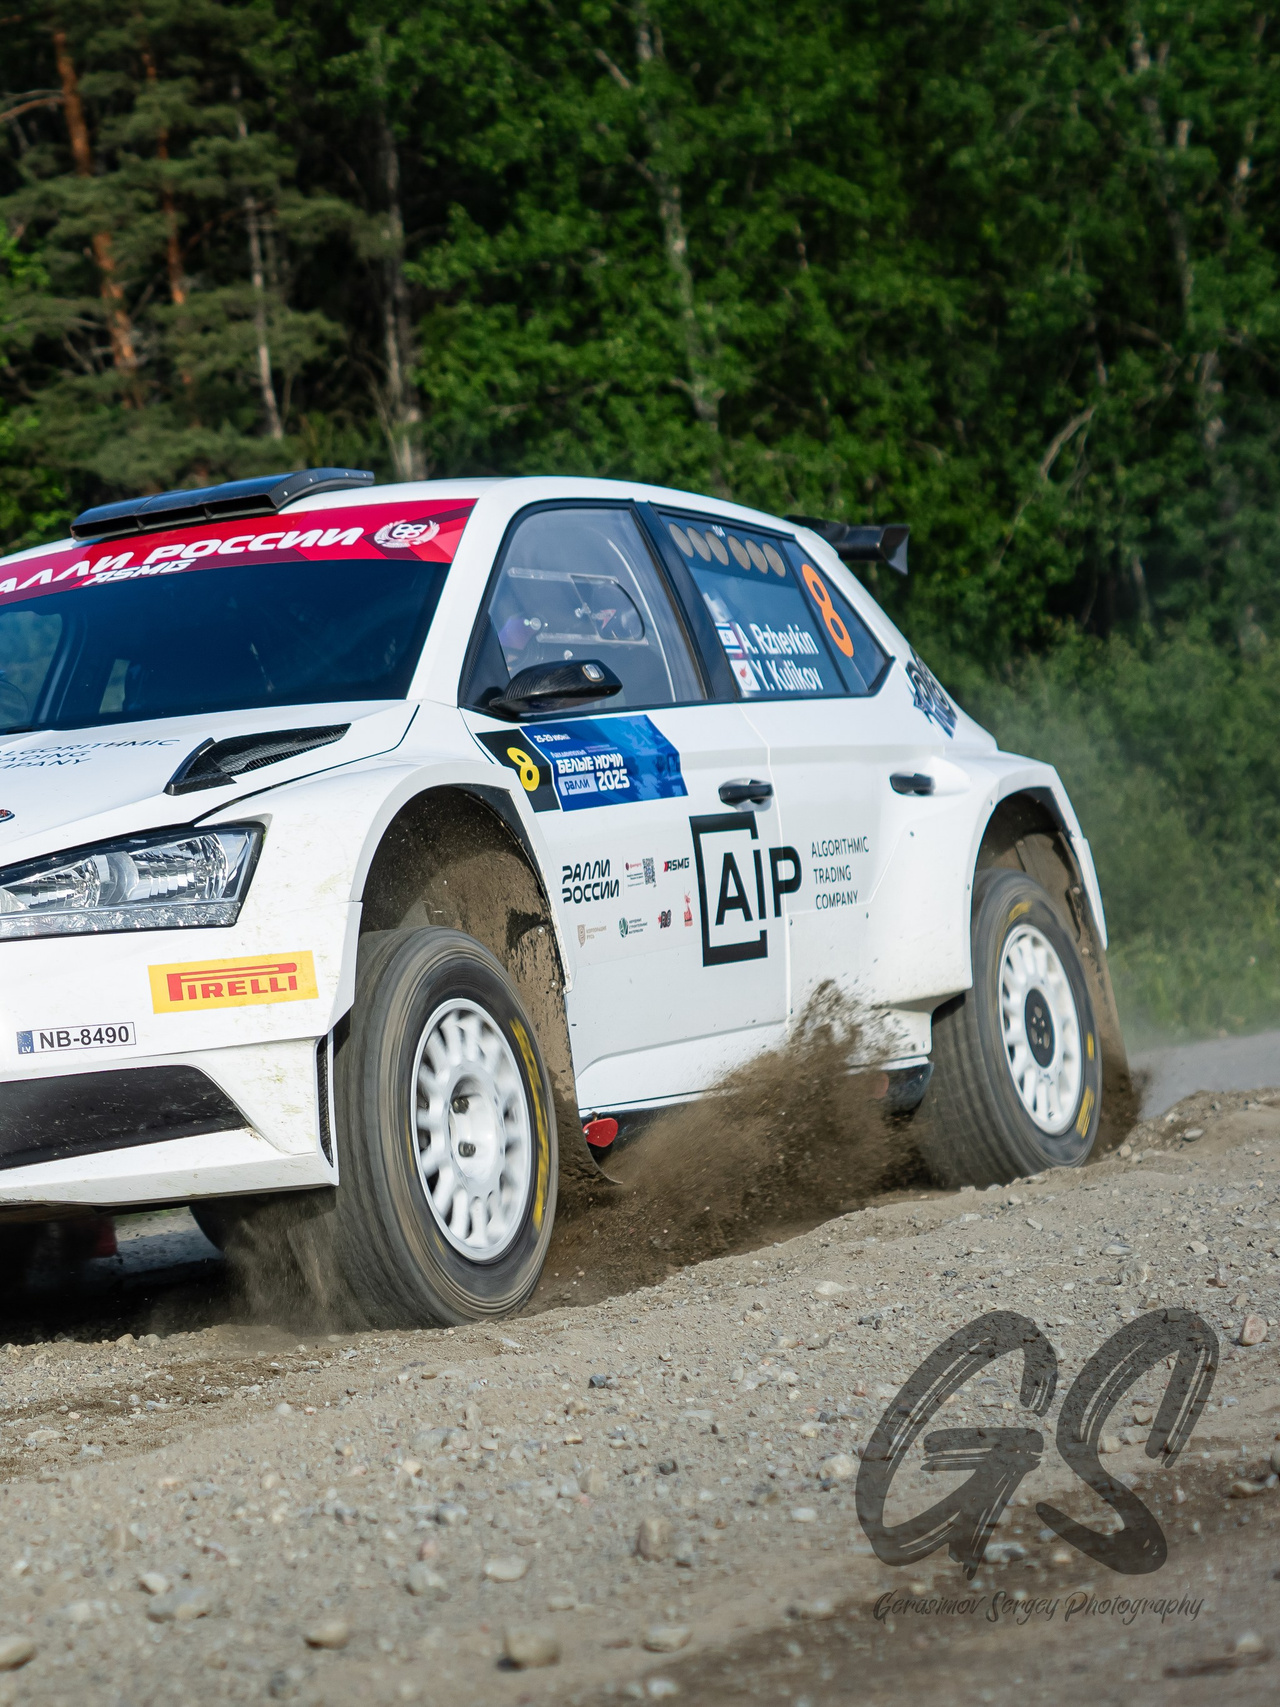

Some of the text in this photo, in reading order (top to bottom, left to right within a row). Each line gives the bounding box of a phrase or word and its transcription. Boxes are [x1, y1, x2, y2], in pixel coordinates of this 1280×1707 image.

[146, 527, 365, 565] РОССИИ
[801, 563, 854, 658] 8
[736, 622, 820, 656] A. Rzhevkin
[753, 658, 825, 692] Y. Kulikov
[506, 746, 540, 792] 8
[556, 755, 595, 775] БЕЛЫЕ
[595, 752, 625, 770] НОЧИ
[564, 779, 591, 792] ралли
[596, 768, 631, 792] 2025
[811, 835, 870, 858] ALGORITHMIC
[561, 858, 611, 885] РАЛЛИ
[813, 864, 852, 884] TRADING
[561, 879, 620, 904] РОССИИ
[815, 889, 859, 911] COMPANY
[166, 962, 298, 1002] PIRELLI
[21, 1045, 32, 1053] LV
[38, 1025, 131, 1050] NB-8490
